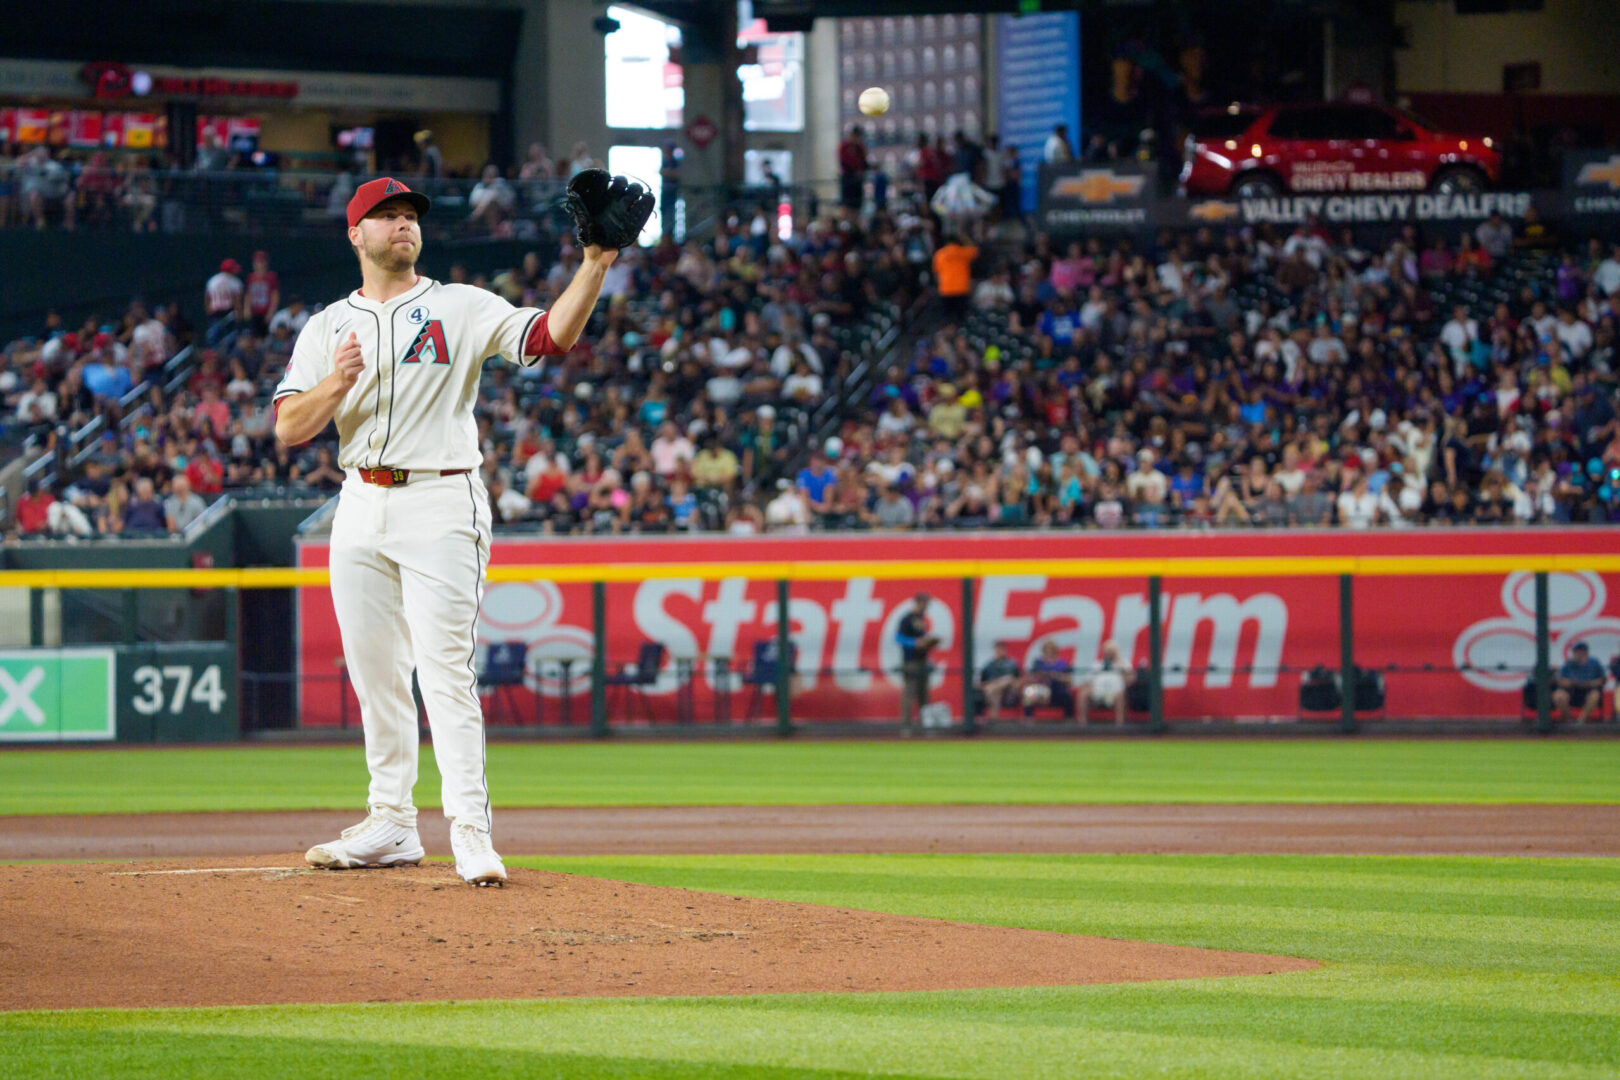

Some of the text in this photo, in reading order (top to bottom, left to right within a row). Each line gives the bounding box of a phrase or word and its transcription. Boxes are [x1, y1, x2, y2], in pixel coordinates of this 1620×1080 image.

[1349, 171, 1427, 191] DEALERS
[1243, 193, 1530, 222] VALLEY CHEVY DEALERS
[410, 307, 423, 322] 4
[400, 319, 451, 365] A
[633, 575, 1289, 696] State Farm
[132, 664, 227, 716] 374
